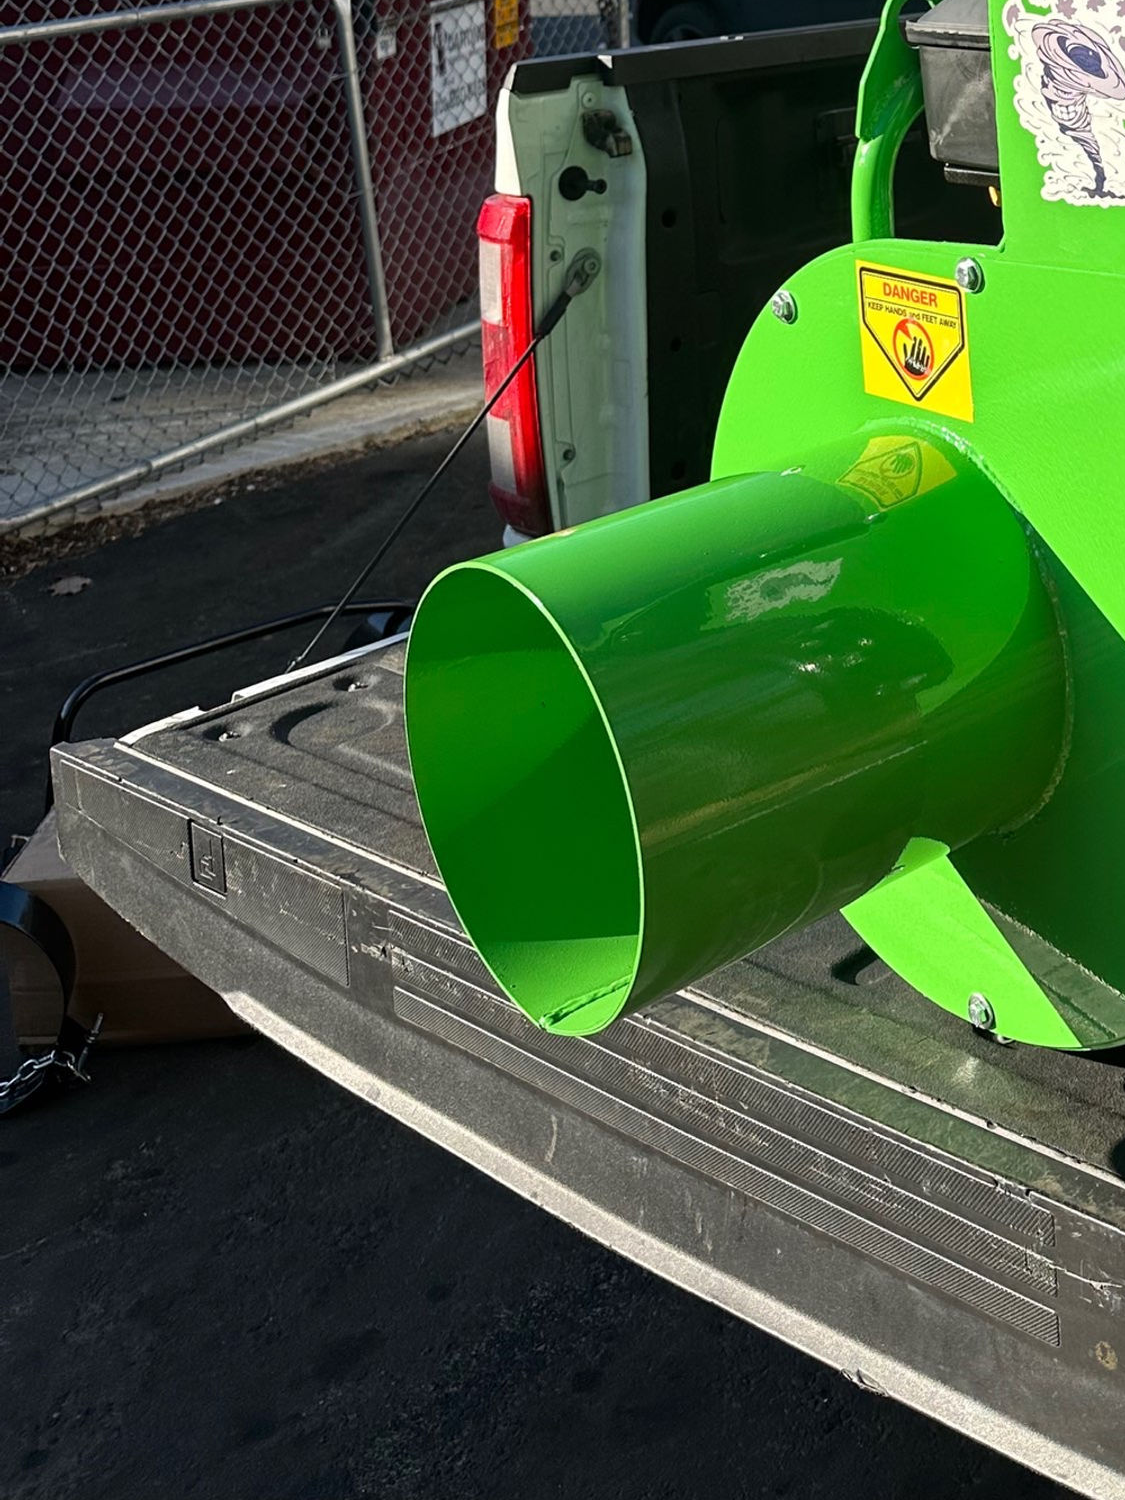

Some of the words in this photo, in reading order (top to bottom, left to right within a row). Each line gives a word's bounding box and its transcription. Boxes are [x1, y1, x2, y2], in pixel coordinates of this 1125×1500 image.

[883, 282, 938, 308] DANGER
[868, 301, 884, 311] KEEP
[885, 305, 907, 317] HANDS
[922, 313, 938, 325] FEET
[940, 317, 957, 329] AWAY
